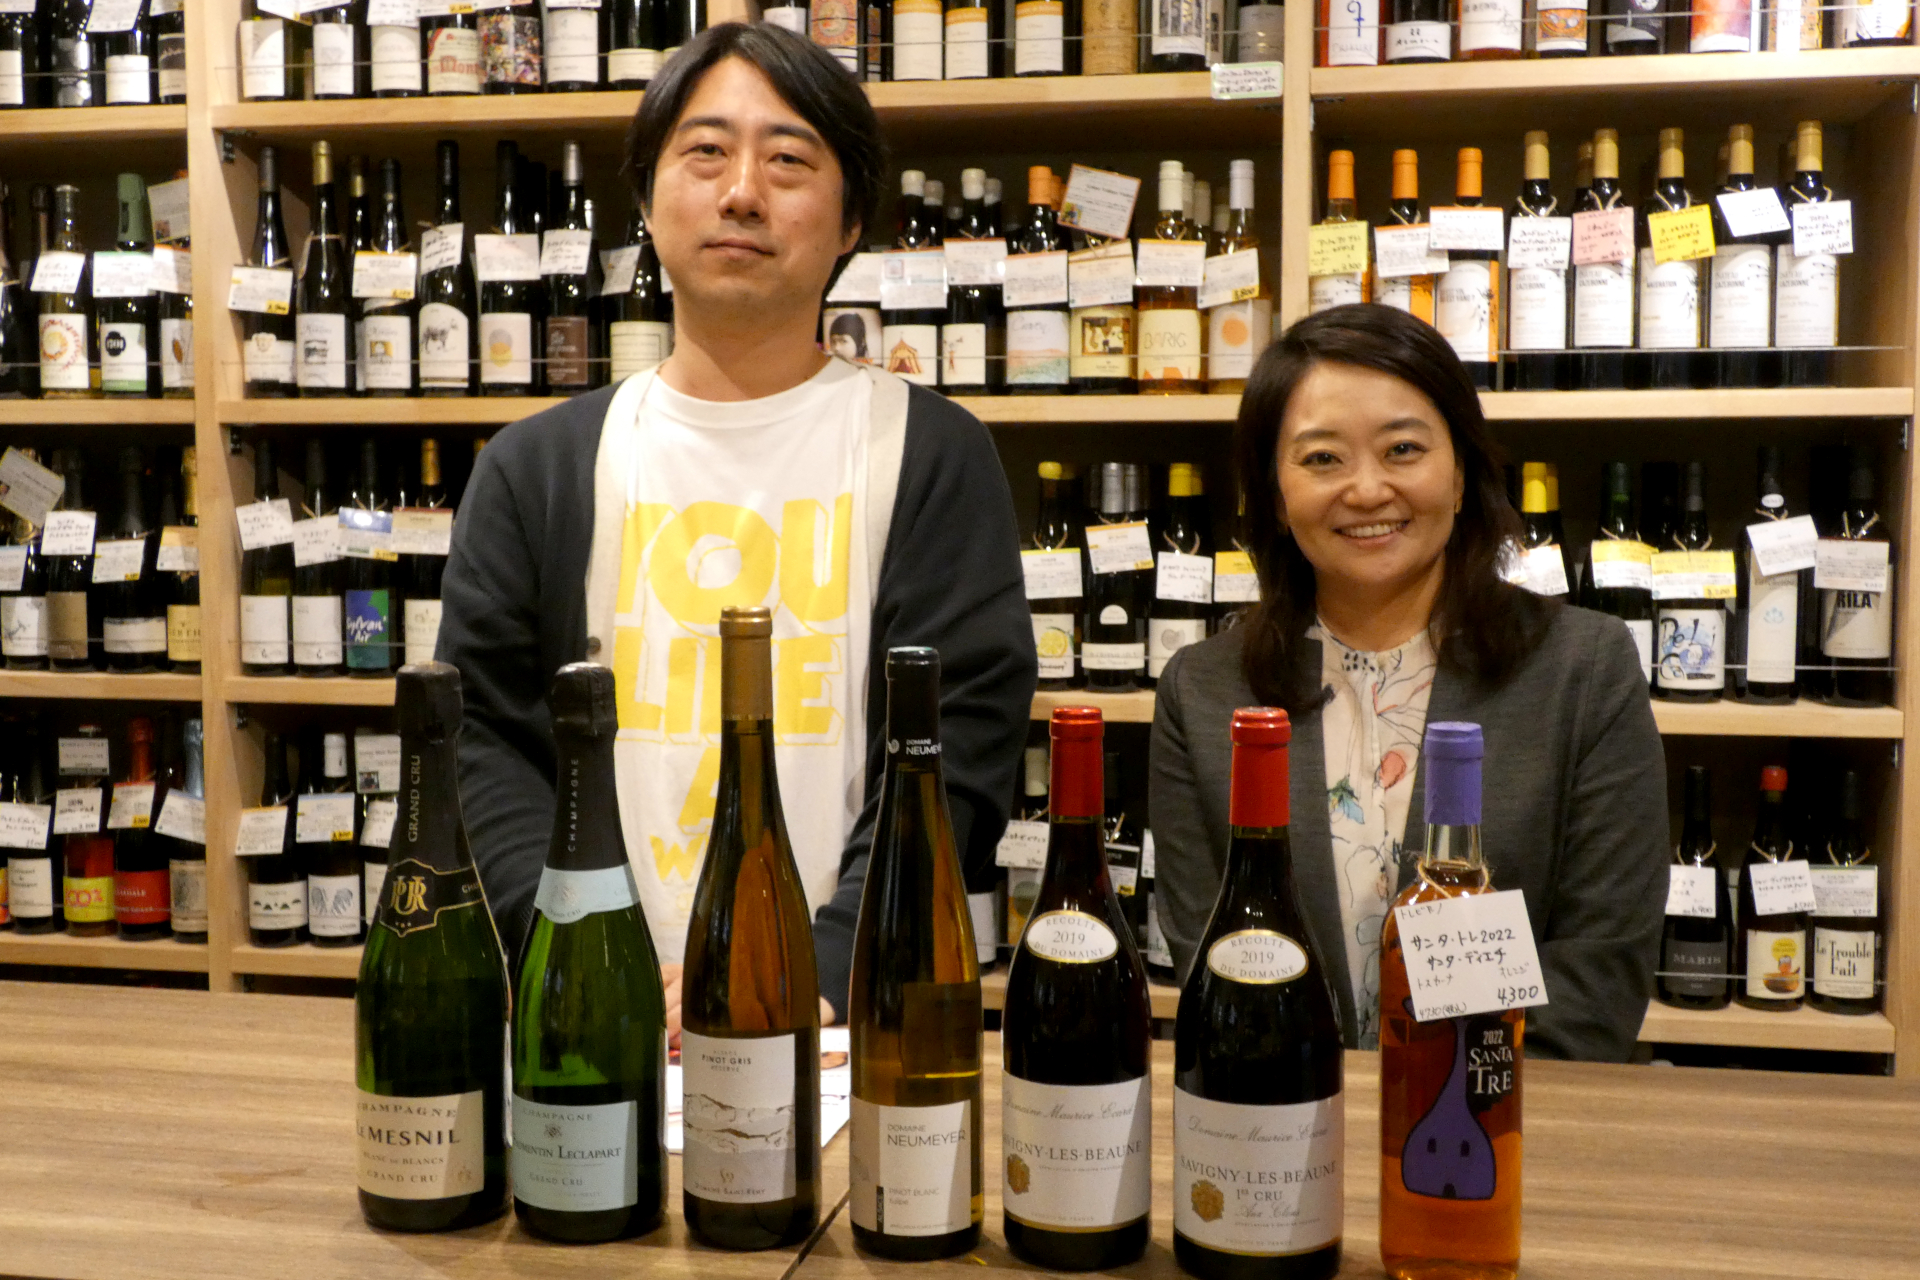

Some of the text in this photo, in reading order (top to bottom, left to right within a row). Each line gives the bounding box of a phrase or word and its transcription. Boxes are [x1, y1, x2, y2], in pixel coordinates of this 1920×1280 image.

[407, 754, 422, 843] GRAND CRU
[567, 758, 579, 853] CHAMPAGNE
[1052, 930, 1086, 945] 2019
[1050, 948, 1105, 960] DOMAINE
[1240, 950, 1275, 964] 2019
[1220, 963, 1295, 979] DU DOMAINE
[1497, 985, 1539, 1008] 4,300
[1483, 1030, 1504, 1045] 2022
[702, 1054, 752, 1065] PINOT GRIS
[1469, 1046, 1513, 1067] SANTA
[1468, 1066, 1512, 1094] TRE
[368, 1126, 460, 1146] MESNIL
[887, 1130, 966, 1147] NEUMEYER
[402, 1157, 445, 1165] BLANCS
[366, 1170, 438, 1183] GRAND CRU
[562, 1177, 583, 1186] CRU
[1254, 1190, 1283, 1201] CRU
